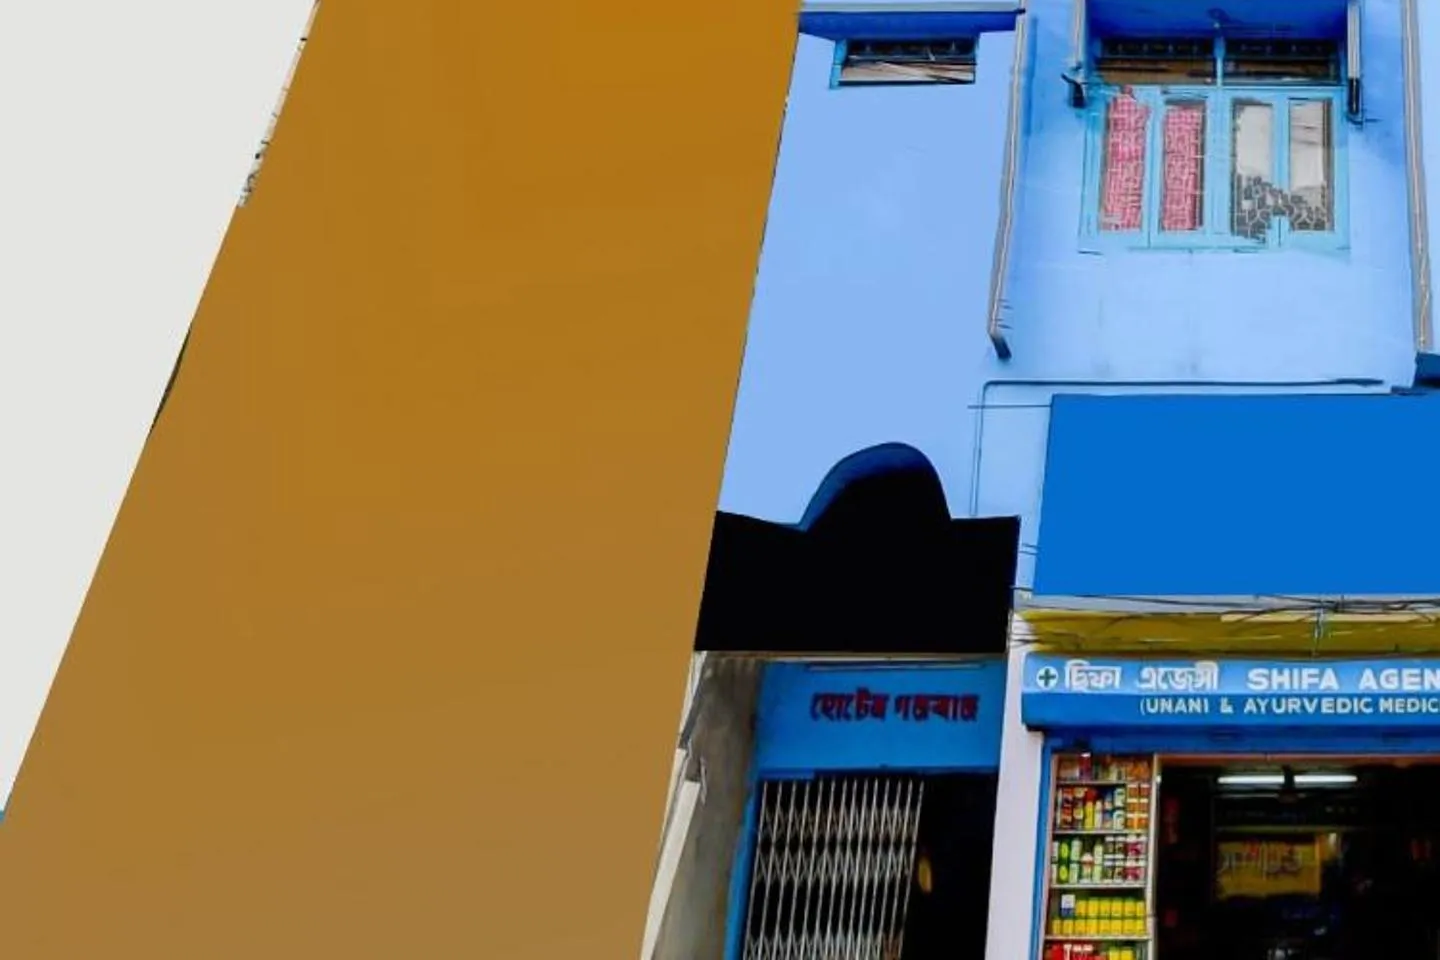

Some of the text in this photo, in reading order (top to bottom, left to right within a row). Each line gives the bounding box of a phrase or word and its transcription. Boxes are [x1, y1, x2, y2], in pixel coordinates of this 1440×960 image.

[1247, 668, 1339, 691] SHIFA
[1220, 699, 1233, 714] &
[1244, 698, 1374, 714] AYURVEDIC
